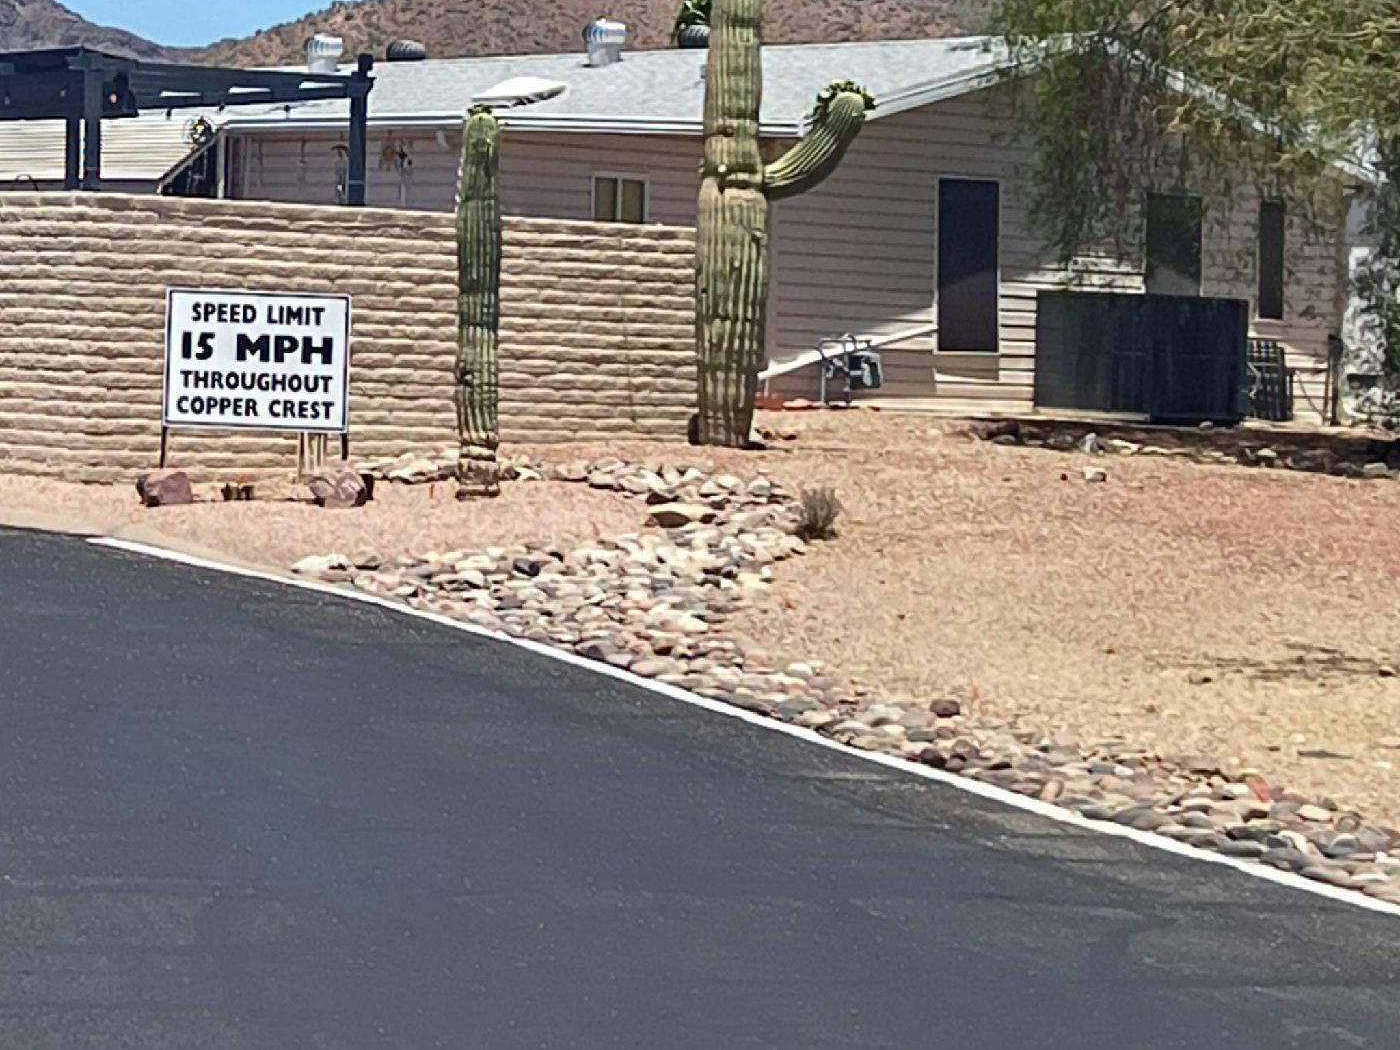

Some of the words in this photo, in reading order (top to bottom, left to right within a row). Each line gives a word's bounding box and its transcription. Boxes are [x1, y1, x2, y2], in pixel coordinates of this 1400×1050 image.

[191, 302, 257, 324] SPEED
[266, 304, 326, 326] LIMIT
[181, 331, 216, 361] 15
[236, 333, 333, 365] MPH
[180, 370, 334, 393] THROUGHOUT
[176, 395, 259, 417] COPPER
[268, 399, 335, 420] CREST
